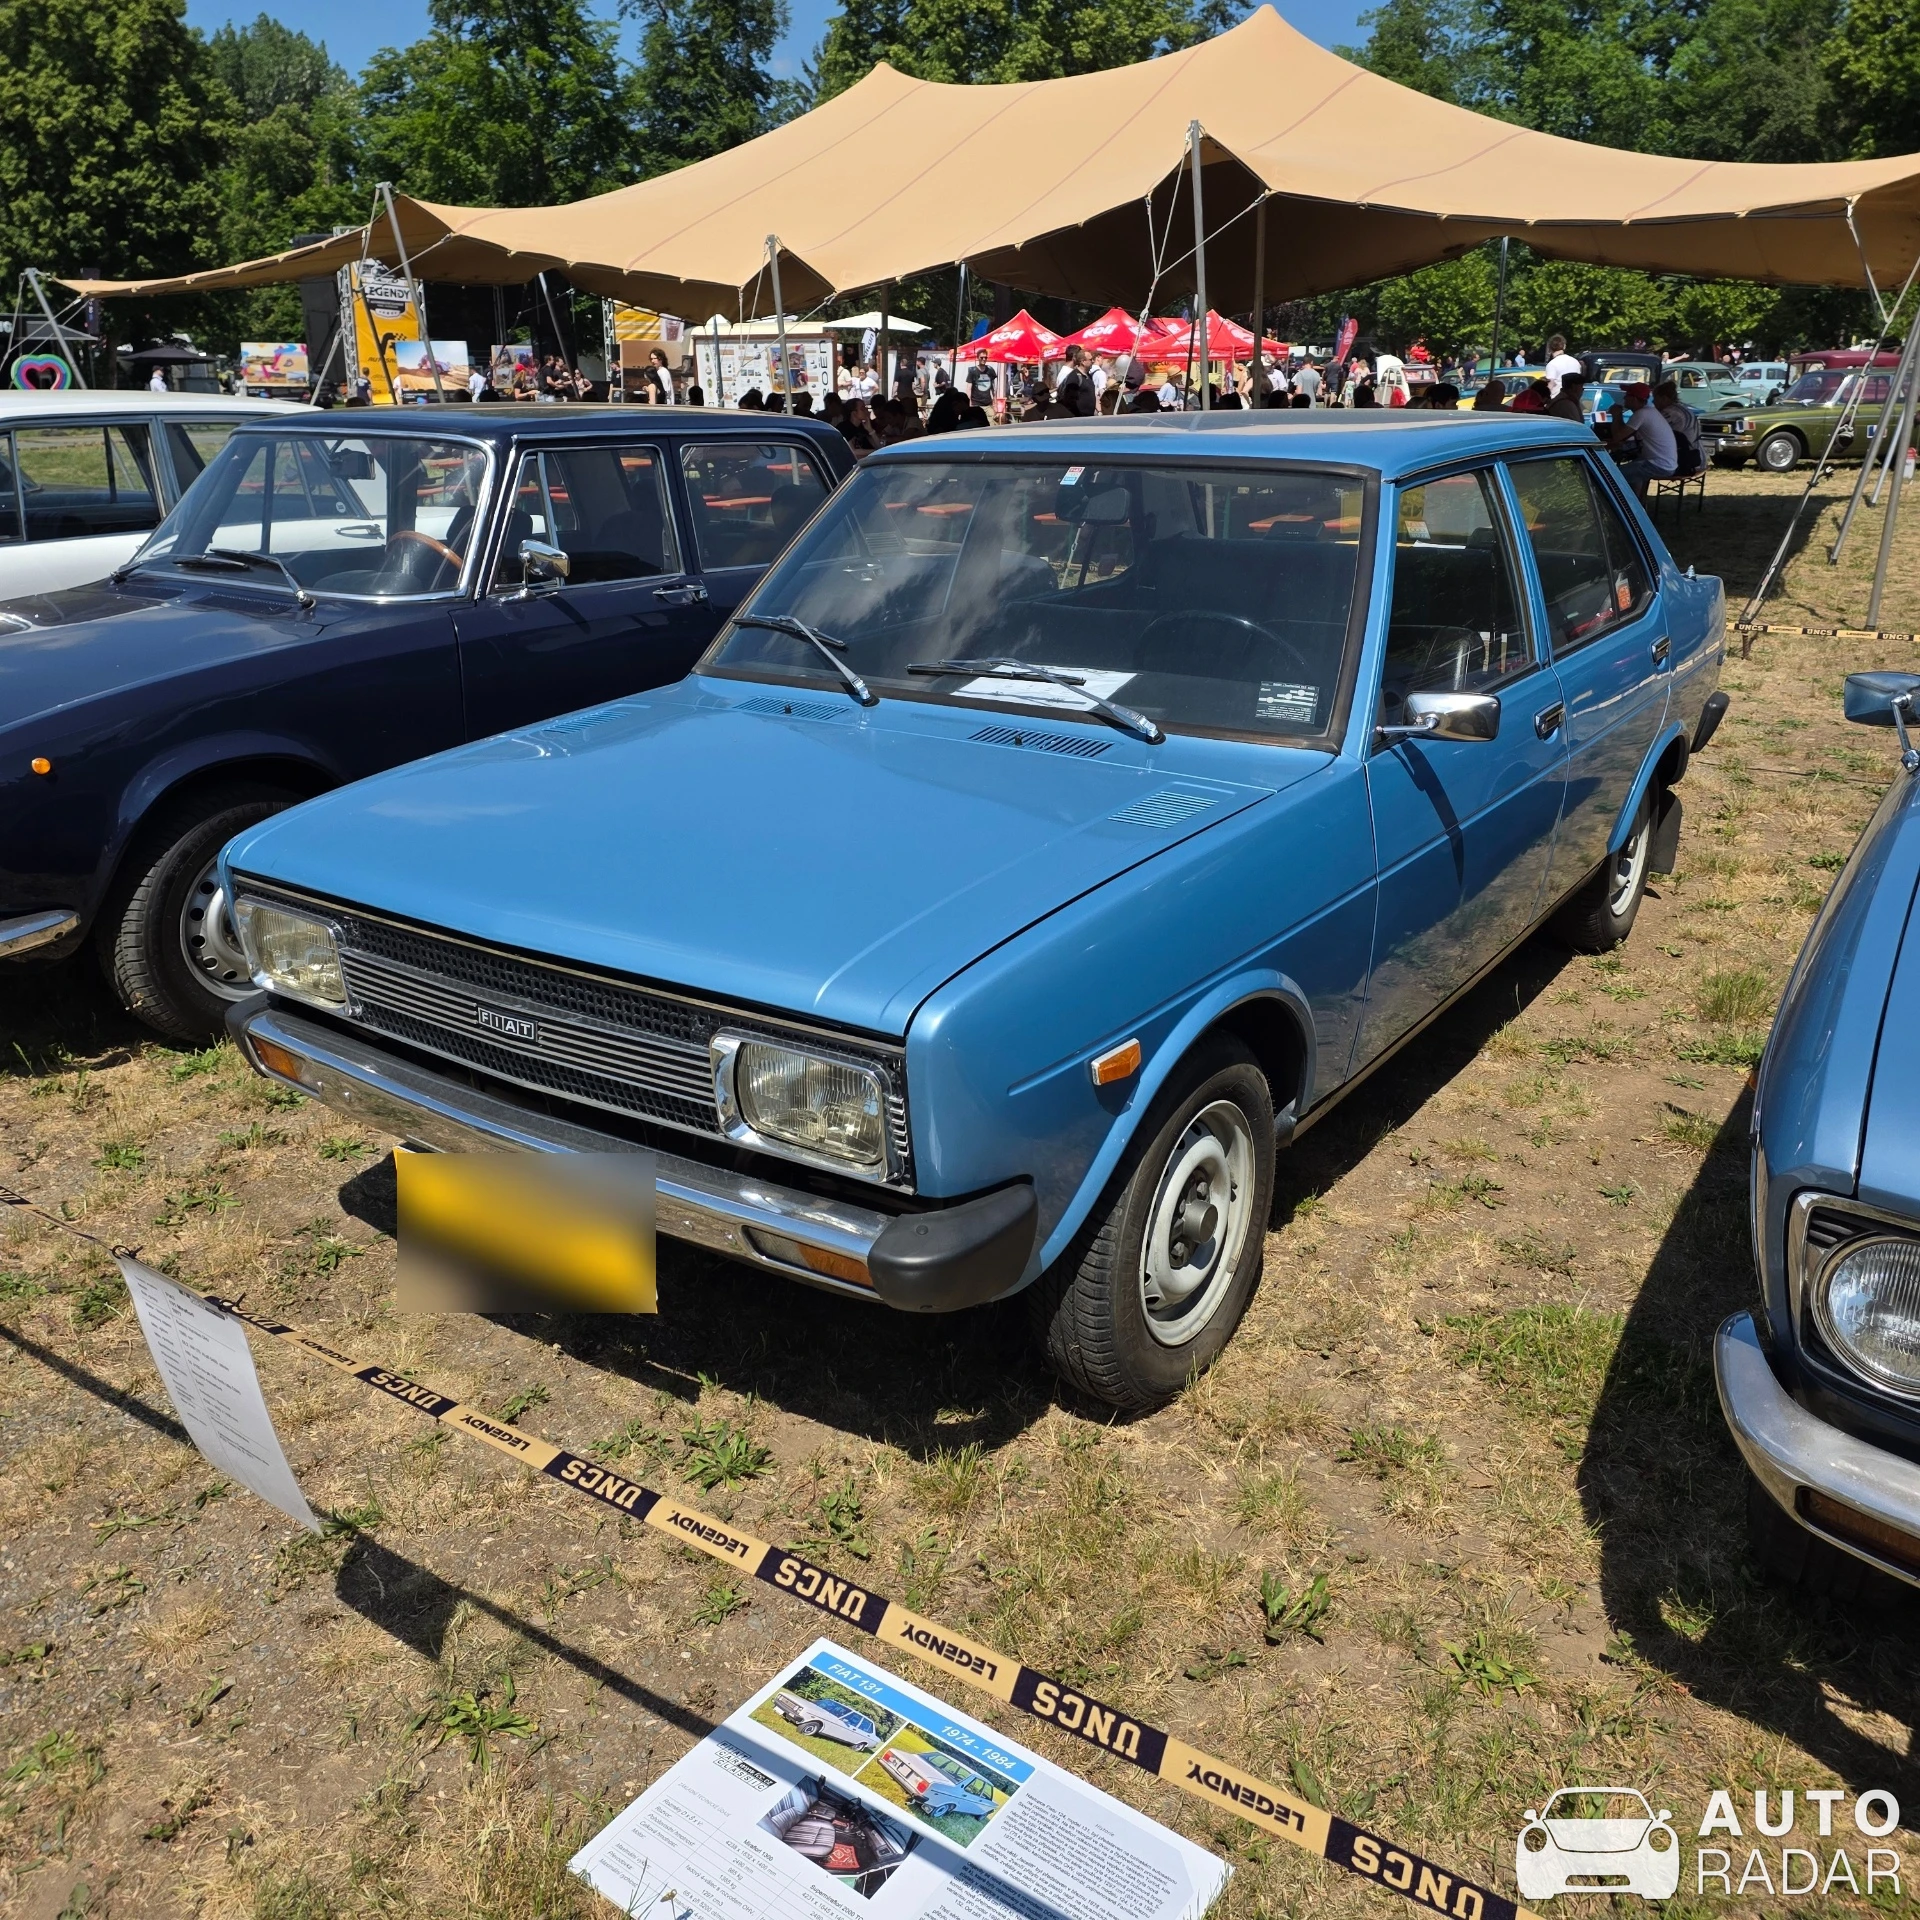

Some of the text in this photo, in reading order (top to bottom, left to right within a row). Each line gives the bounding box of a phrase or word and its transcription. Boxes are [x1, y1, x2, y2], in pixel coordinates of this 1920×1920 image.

[366, 286, 410, 299] EGENDY
[1738, 623, 1764, 632] UNCS
[1806, 628, 1833, 636] UNCS
[1882, 633, 1910, 641] UNCS
[481, 1011, 531, 1035] FIAT
[296, 1338, 358, 1366] LEGENDY
[370, 1371, 443, 1410] UNCS
[459, 1414, 531, 1452] LEGENDY
[560, 1459, 642, 1510] UNCS
[666, 1511, 750, 1558] LEGENDY
[774, 1557, 867, 1622] UNCS
[900, 1622, 998, 1681] LEGENDY
[1032, 1681, 1142, 1760] UNCS
[1186, 1763, 1306, 1833] LEGENDY
[1351, 1835, 1485, 1920] UNCS
[828, 1663, 859, 1682] FIAT
[858, 1679, 883, 1695] 131
[941, 1725, 973, 1747] 1974
[981, 1748, 1017, 1770] 1984
[719, 1741, 750, 1760] FIAT
[719, 1751, 740, 1765] CAR
[717, 1759, 765, 1790] CLASSIC
[1095, 1824, 1116, 1837] Historie
[744, 1840, 775, 1861] Mirafiori 1300
[809, 1885, 844, 1909] Supermirafiori
[842, 1906, 857, 1917] 2000
